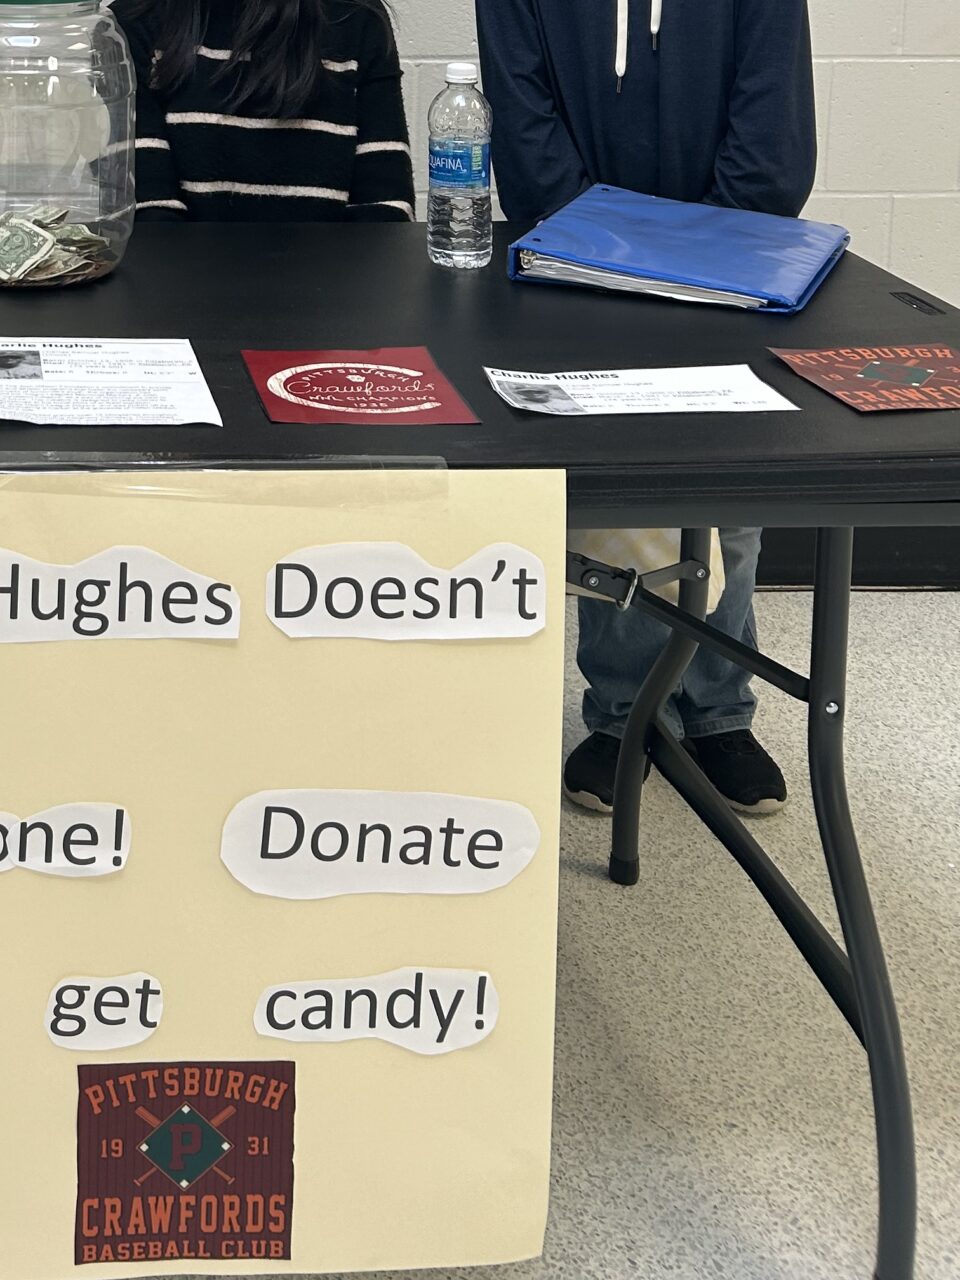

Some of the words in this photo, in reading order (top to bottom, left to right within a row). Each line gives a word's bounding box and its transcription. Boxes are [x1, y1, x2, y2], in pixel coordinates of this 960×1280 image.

[429, 154, 464, 170] QUAFINA
[782, 347, 954, 366] PITTSBURGH
[302, 368, 410, 382] PITTSBURGH
[490, 370, 550, 381] Charlie
[554, 372, 620, 381] Hughes
[287, 380, 435, 396] Crawfords
[259, 806, 504, 869] Donate
[49, 978, 161, 1037] get
[264, 972, 488, 1044] candy!
[84, 1067, 289, 1115] PITTSBURGH
[100, 1138, 124, 1158] 19
[169, 1123, 202, 1170] P
[247, 1136, 269, 1155] 31
[82, 1194, 286, 1238] CRAWFORDS
[83, 1240, 211, 1262] BASEBALL
[221, 1240, 285, 1257] CLUB
